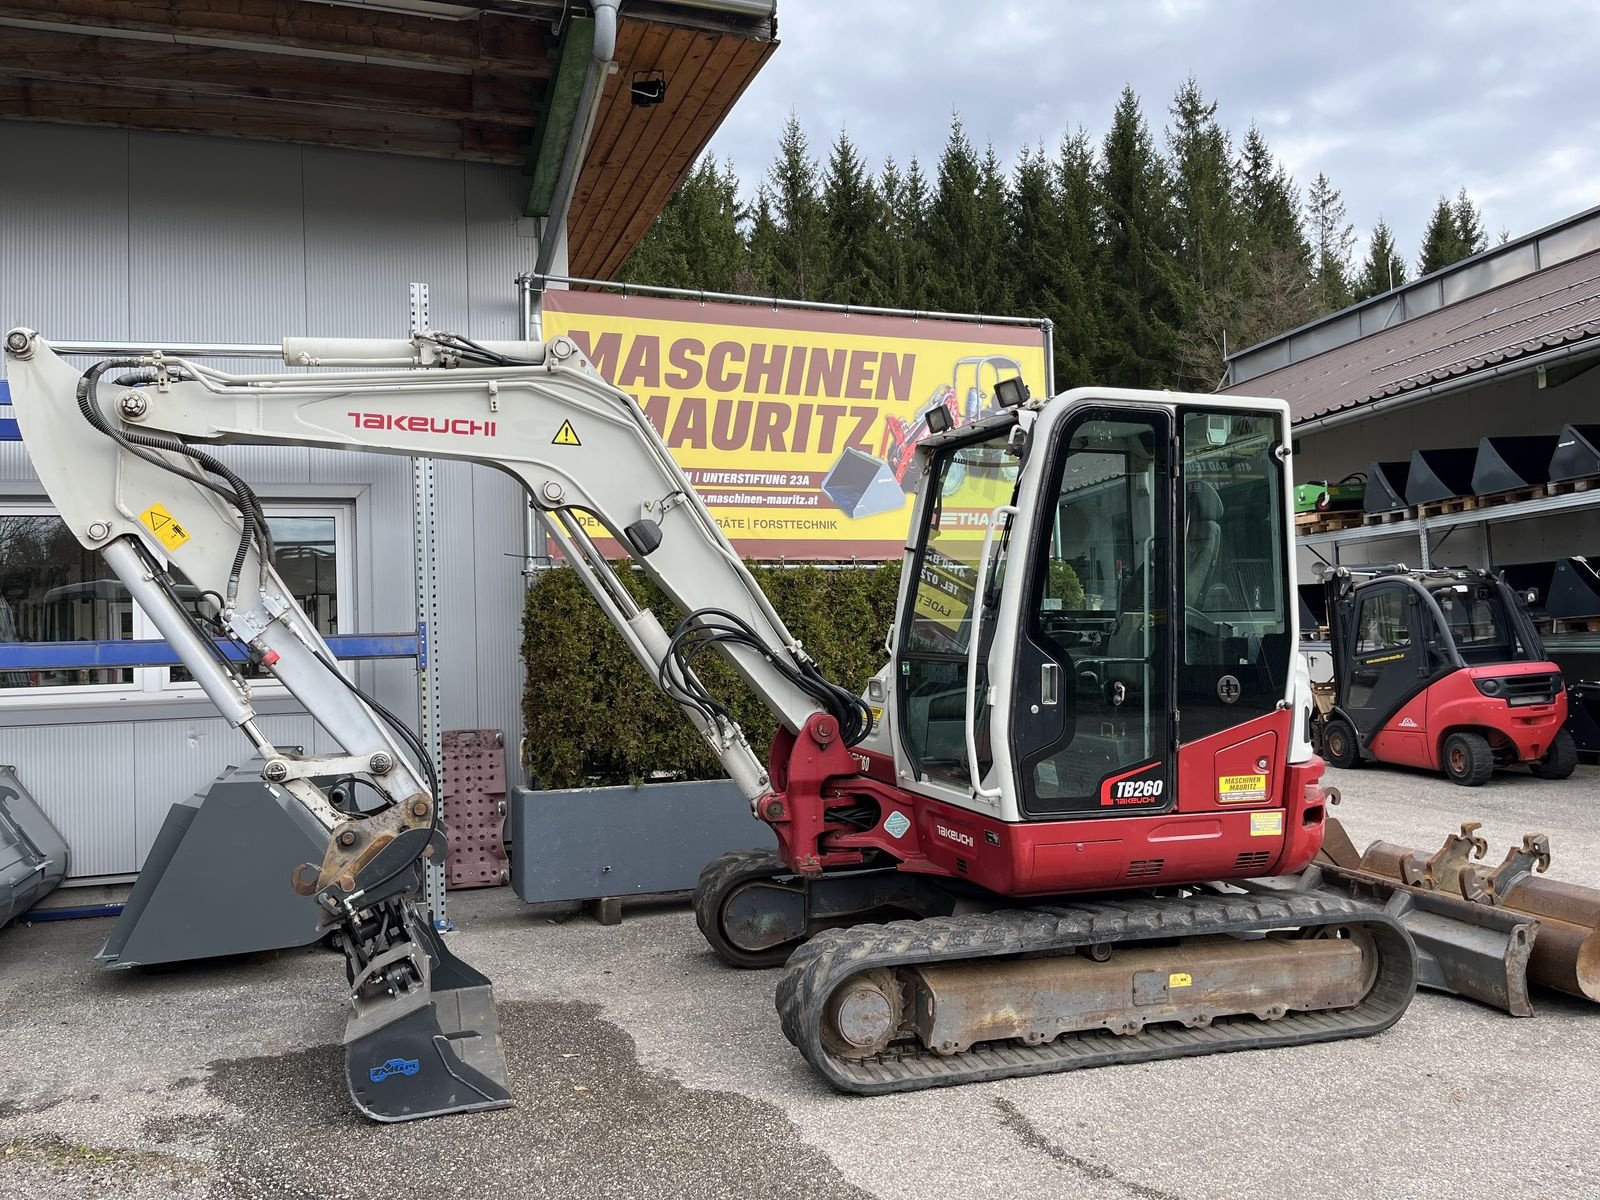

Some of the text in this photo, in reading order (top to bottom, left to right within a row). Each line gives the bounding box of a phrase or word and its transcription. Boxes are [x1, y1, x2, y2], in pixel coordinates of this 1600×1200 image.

[567, 330, 917, 401] MASCHINEN
[702, 472, 787, 485] UNTERSTIFTUNG
[789, 475, 810, 486] 23A
[753, 519, 838, 530] FORSTTECHNIK
[1225, 776, 1262, 785] MASCHINEN
[1116, 779, 1164, 798] TB260
[1229, 783, 1257, 792] MAURITZ
